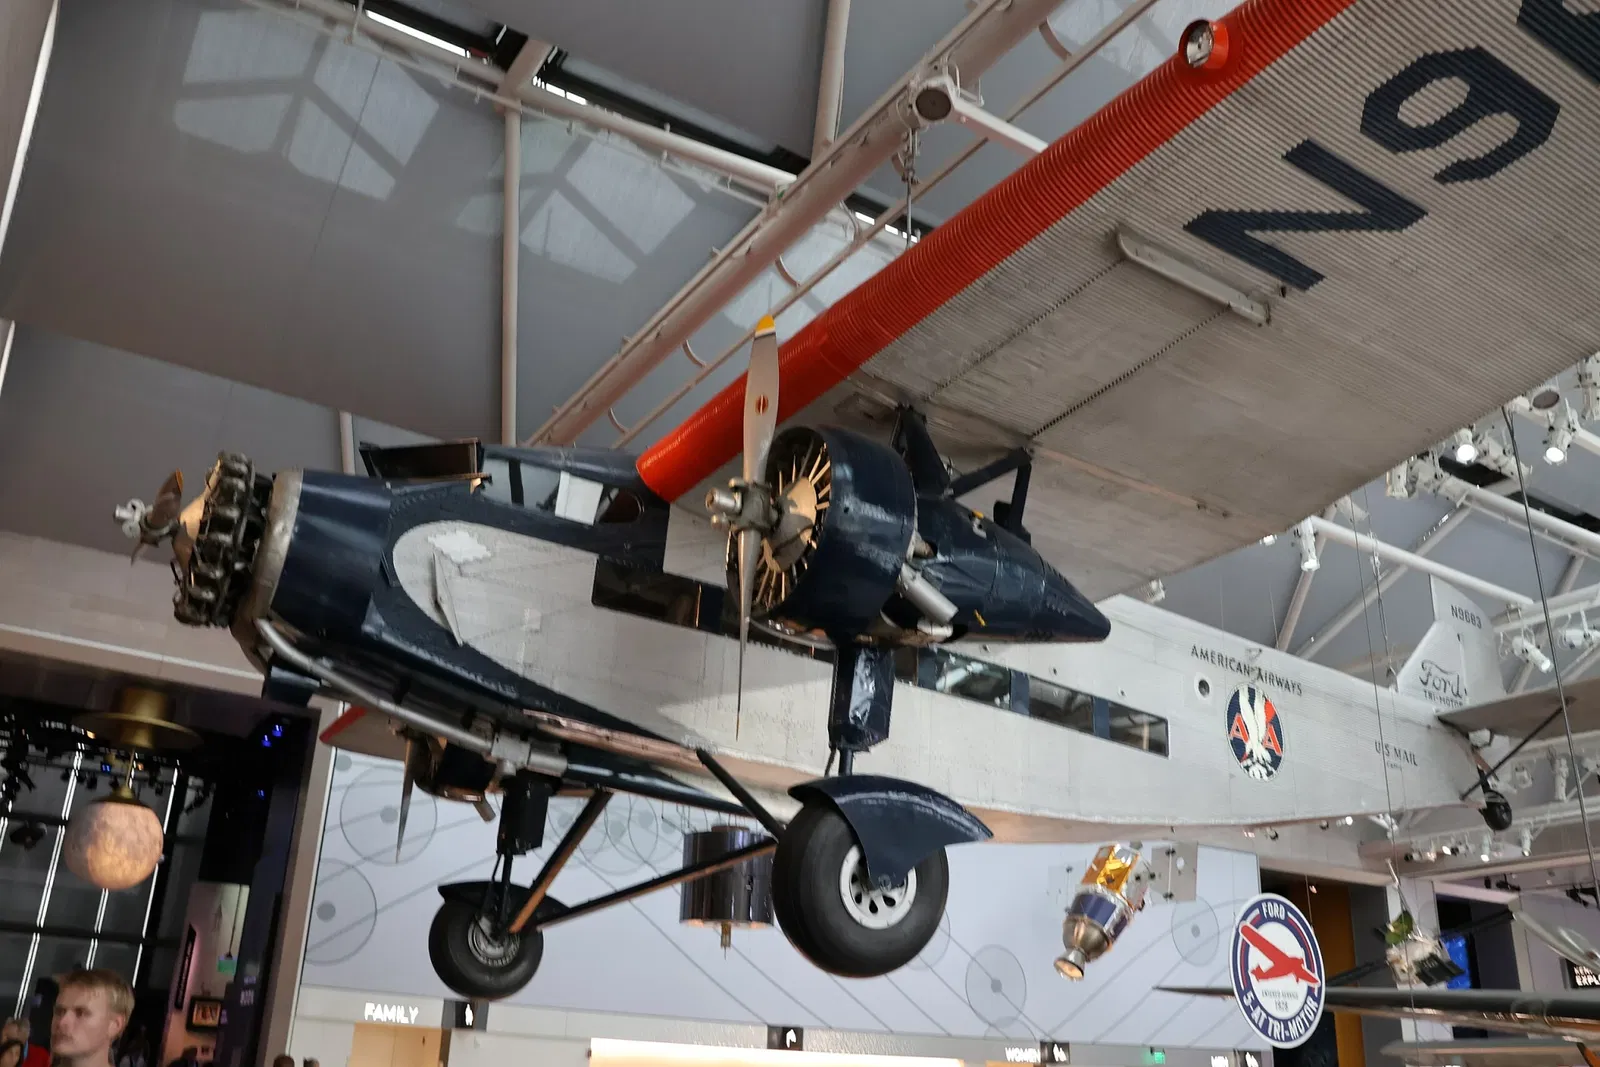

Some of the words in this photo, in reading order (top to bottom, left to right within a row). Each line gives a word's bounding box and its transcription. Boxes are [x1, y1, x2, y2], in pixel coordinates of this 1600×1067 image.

[1190, 643, 1250, 677] AMERICAN
[1256, 667, 1303, 698] AIRWAYS
[1419, 659, 1463, 699] Ford
[1261, 901, 1286, 921] FORD
[364, 1002, 419, 1025] FAMILY
[1267, 995, 1318, 1041] TRI-MOTOR
[1005, 1047, 1041, 1063] WOMEN
